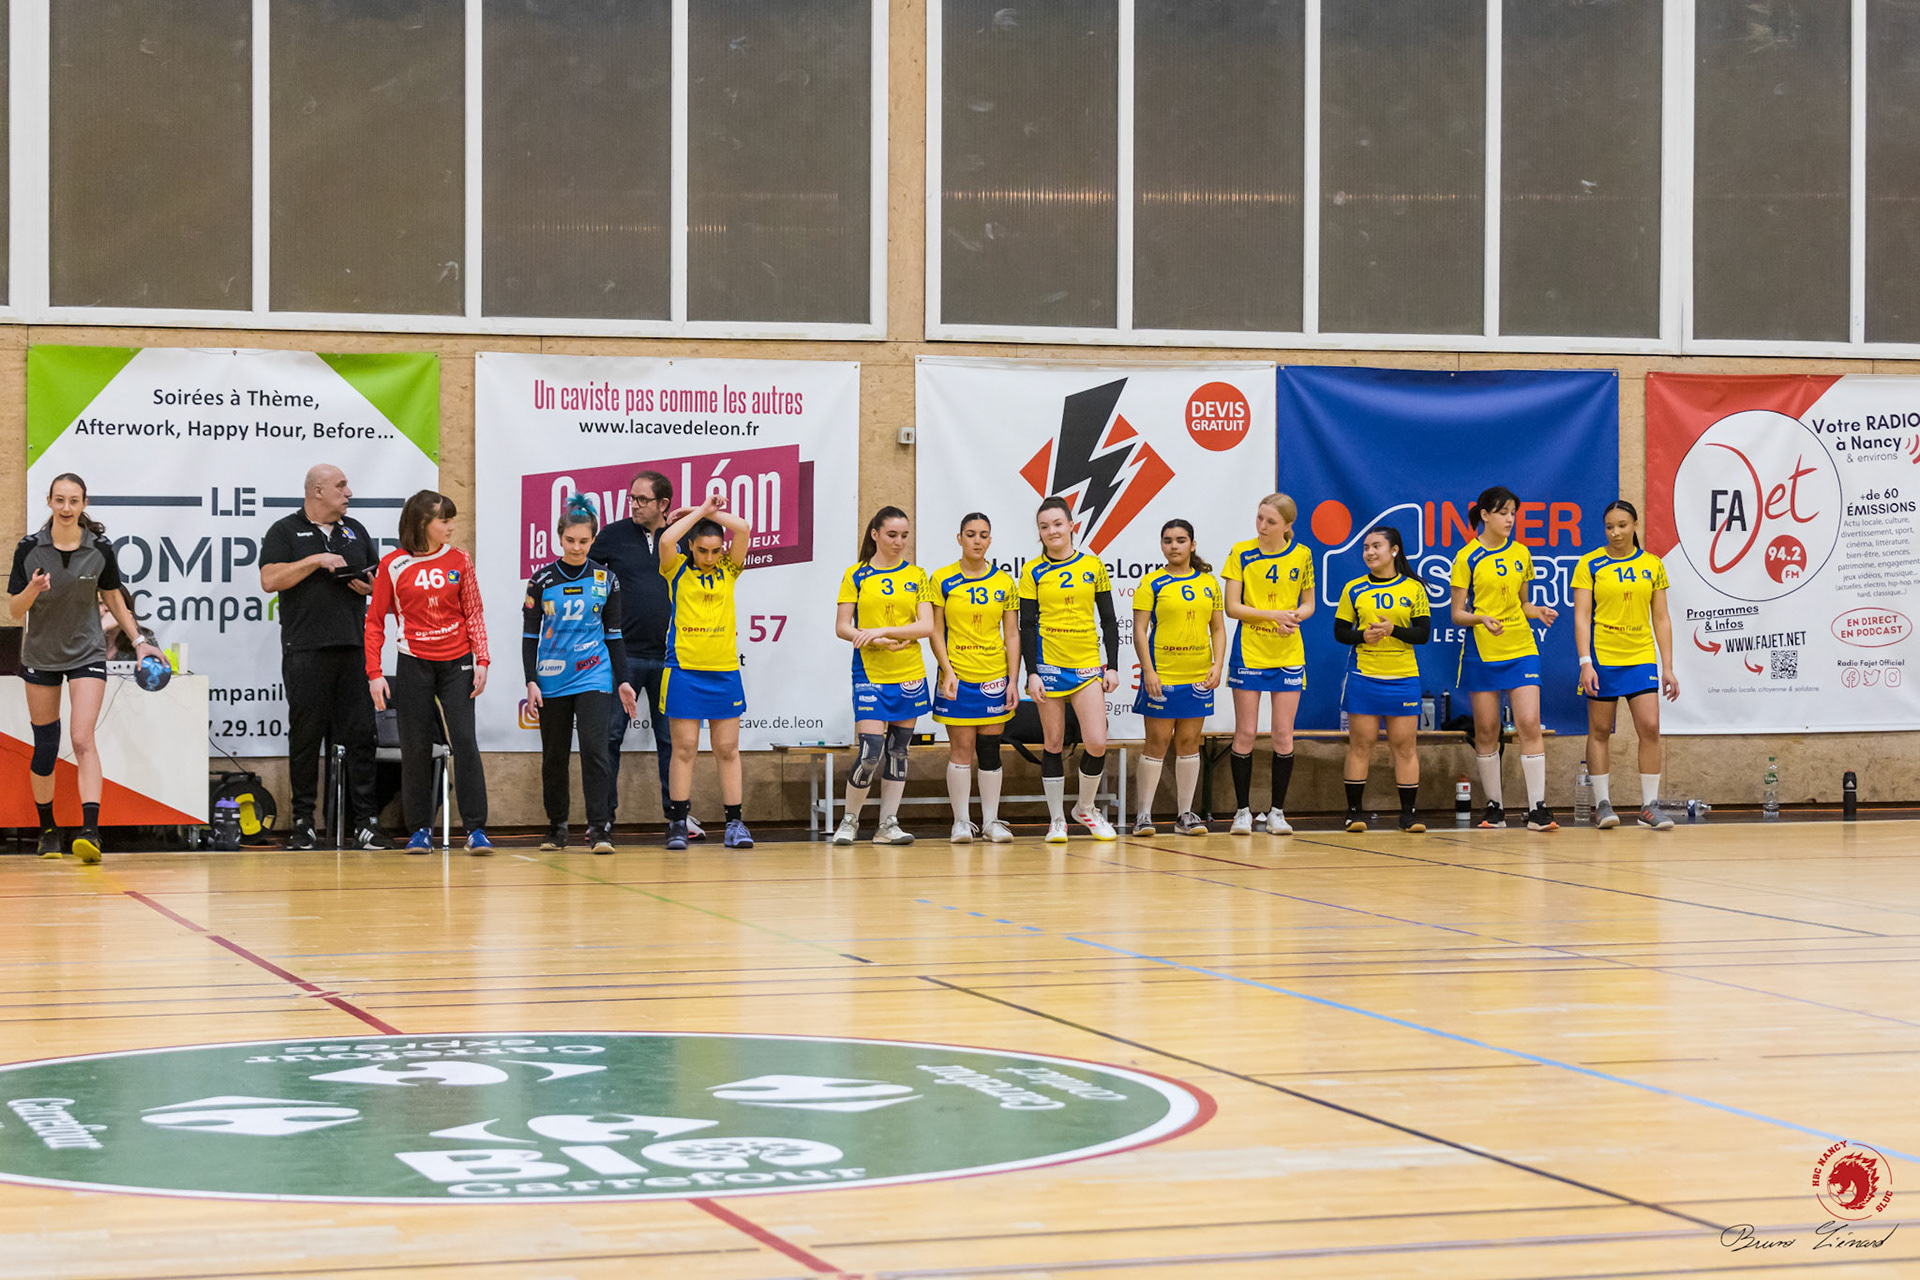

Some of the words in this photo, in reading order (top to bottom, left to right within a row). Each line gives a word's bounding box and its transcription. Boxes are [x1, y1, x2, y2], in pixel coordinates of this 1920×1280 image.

[153, 387, 224, 406] Soirées
[230, 391, 241, 407] à
[247, 391, 320, 410] Thème,
[534, 379, 554, 410] Un
[560, 381, 620, 412] caviste
[625, 390, 654, 416] pas
[659, 390, 718, 413] comme
[723, 384, 746, 414] les
[752, 386, 803, 415] autres
[1191, 401, 1245, 419] DEVIS
[75, 420, 181, 440] Afterwork,
[188, 421, 249, 440] Happy
[255, 422, 307, 440] Hour,
[313, 424, 395, 440] Before...
[579, 419, 760, 437] www.lacavedeleon.fr
[1191, 419, 1245, 432] GRATUIT
[1812, 418, 1860, 434] Votre
[1866, 412, 1920, 431] RADIO
[1836, 436, 1846, 451] à
[1851, 436, 1902, 452] Nancy
[1847, 453, 1854, 463] &
[1857, 452, 1898, 463] environs
[212, 487, 256, 516] LE
[1884, 488, 1899, 499] 60
[1847, 502, 1917, 516] ÉMISSIONS
[1425, 501, 1582, 547] INER
[529, 523, 547, 559] la
[1767, 546, 1801, 561] 94.2
[1265, 564, 1279, 583] 4
[1495, 558, 1507, 576] 5
[1613, 567, 1637, 583] 14
[1785, 570, 1800, 579] FM
[415, 568, 445, 590] 46
[697, 573, 714, 590] 11
[881, 578, 894, 595] 3
[1059, 571, 1074, 588] 2
[966, 587, 989, 605] 13
[1181, 585, 1195, 601] 6
[1371, 593, 1394, 609] 10
[562, 599, 585, 621] 12
[1686, 605, 1759, 621] Programmes
[1704, 621, 1712, 631] &
[1715, 618, 1744, 631] Infos
[1847, 618, 1859, 627] EN
[1861, 615, 1898, 625] DIRECT
[1841, 630, 1854, 638] EN
[1856, 626, 1902, 637] PODCAST
[1725, 631, 1806, 653] WWW.FAJET.NET
[1860, 660, 1877, 668] Fajet
[739, 716, 824, 729] cave.de.leon
[245, 1046, 605, 1063] Carrefour
[285, 1039, 535, 1053] express
[447, 1167, 866, 1196] Carrefour
